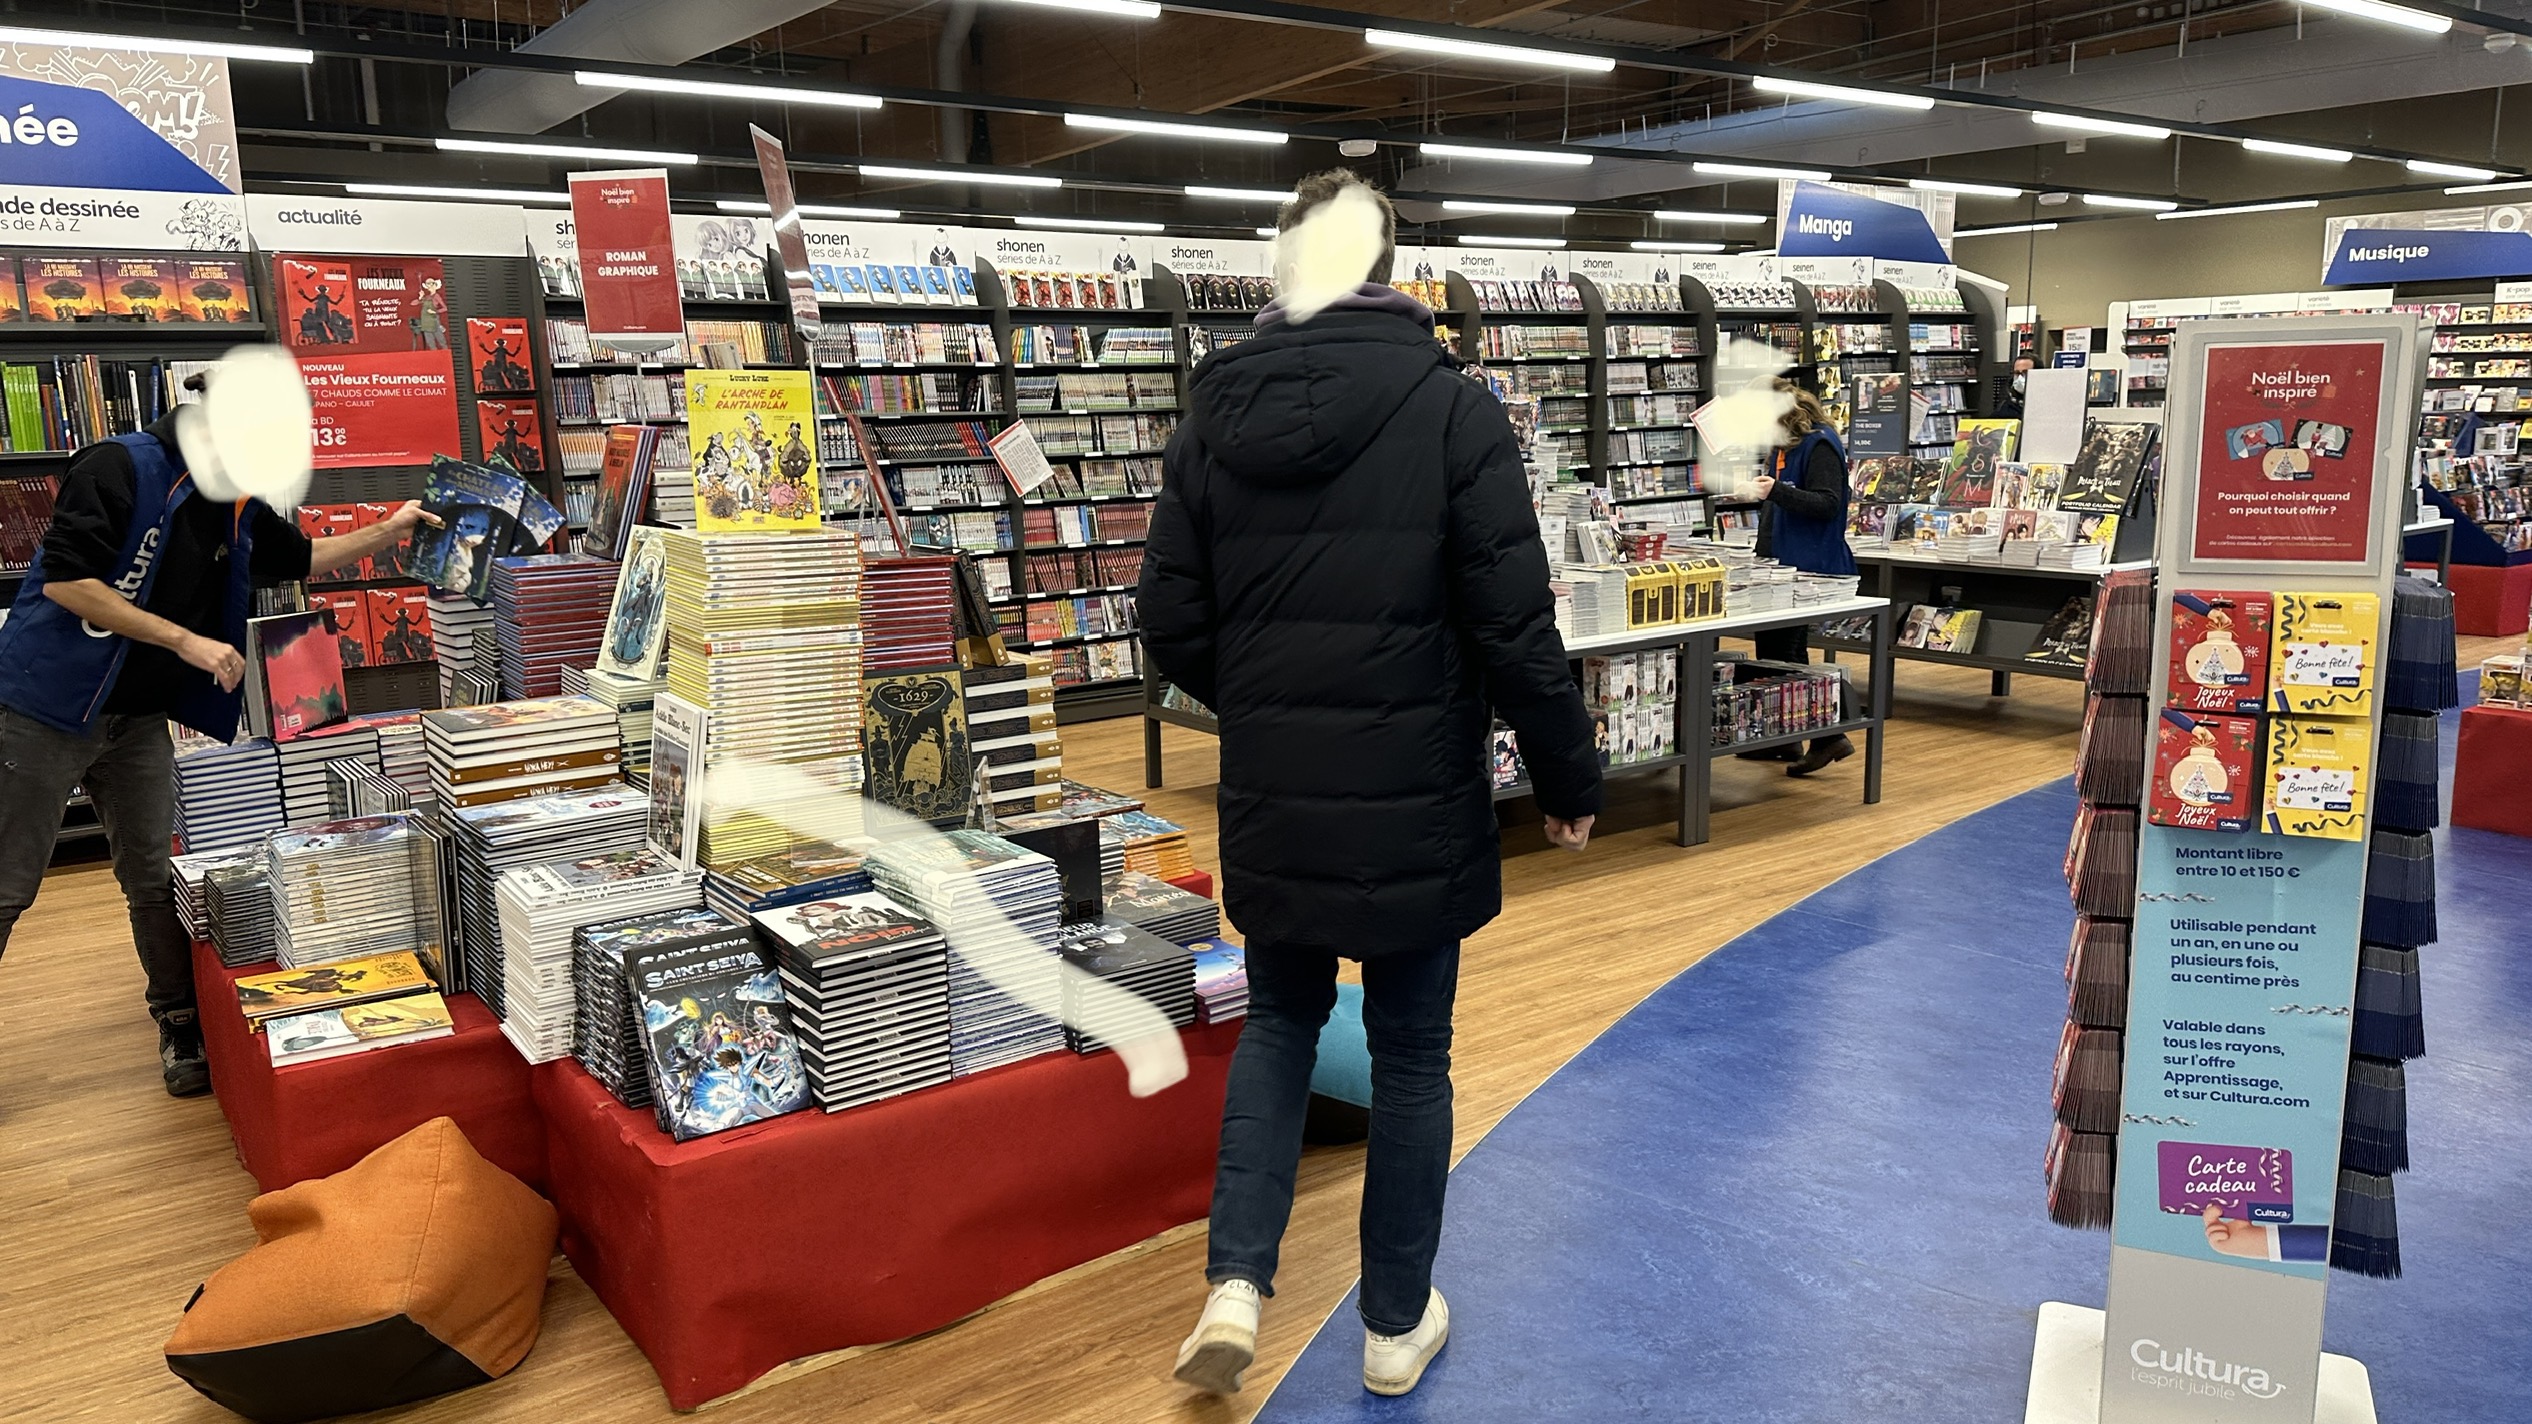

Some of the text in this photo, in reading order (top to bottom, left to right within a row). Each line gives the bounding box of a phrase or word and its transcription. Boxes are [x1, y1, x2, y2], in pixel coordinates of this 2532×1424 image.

[601, 187, 619, 196] Noël
[40, 198, 140, 219] dessinée
[277, 208, 363, 226] actualité
[13, 216, 81, 232] de A à Z
[1799, 214, 1853, 242] Manga
[996, 238, 1045, 253] shonen
[605, 251, 647, 262] ROMAN
[827, 247, 841, 258] de
[844, 247, 852, 258] A
[862, 248, 870, 259] Z
[997, 253, 1024, 264] séries
[1025, 254, 1037, 264] de
[1039, 254, 1046, 264] A
[1055, 255, 1062, 265] Z
[1171, 246, 1214, 259] shonen
[2348, 244, 2430, 263] Musique
[1171, 260, 1195, 270] séries
[1196, 260, 1207, 270] de
[1208, 260, 1215, 270] A
[1222, 261, 1228, 270] Z
[1460, 254, 1495, 267] shonen
[1582, 258, 1613, 269] shonen
[1692, 261, 1717, 271] seinen
[597, 265, 659, 277] GRAPHIQUE
[1792, 263, 1815, 272] seinen
[1883, 266, 1904, 276] seinen
[357, 277, 406, 291] FOURNEAUX
[302, 364, 345, 372] NOUVEAU
[304, 374, 446, 386] Les Vieux Fourneaux
[2251, 370, 2331, 385] Noël bien
[321, 389, 362, 398] CHAUDS
[365, 388, 401, 397] COMME
[403, 388, 413, 397] LE
[414, 387, 448, 397] CLIMAT
[721, 388, 785, 399] L'ARCHE DE
[2264, 384, 2318, 402] inspiré
[715, 400, 789, 410] RANTANPLAN
[320, 417, 334, 425] BD
[2217, 491, 2351, 503] Pourquoi choisir quand
[2228, 505, 2337, 516] on peut tout offrir ?
[2295, 657, 2326, 669] Bonne
[898, 690, 929, 703] 1629
[2193, 686, 2235, 703] Joyeux
[2196, 697, 2228, 709] Noël
[2287, 782, 2318, 793] Bonne
[2175, 803, 2217, 818] Joyeux
[2178, 813, 2209, 826] Noël
[2176, 847, 2284, 860] Montant libre
[2176, 865, 2301, 878] entre 10 et 150 €
[2170, 918, 2317, 936] Utilisable pendant
[817, 925, 916, 950] NOIR
[2170, 938, 2299, 952] un an, en une ou
[2171, 953, 2279, 971] plusieurs fois,
[645, 951, 763, 989] SAINT SEIYA
[2171, 973, 2300, 990] au centime près
[2163, 1019, 2266, 1036] Valable dans
[2163, 1036, 2285, 1057] tous les rayons,
[2163, 1054, 2189, 1065] sur
[2163, 1070, 2284, 1091] Apprentissage,
[2163, 1088, 2310, 1108] et sur Cultura.com
[2187, 1154, 2248, 1176] Carte
[2185, 1175, 2257, 1194] cadeau
[2254, 1208, 2290, 1219] Cultura
[2130, 1338, 2282, 1398] Cultura
[2186, 1379, 2236, 1402] jubile
